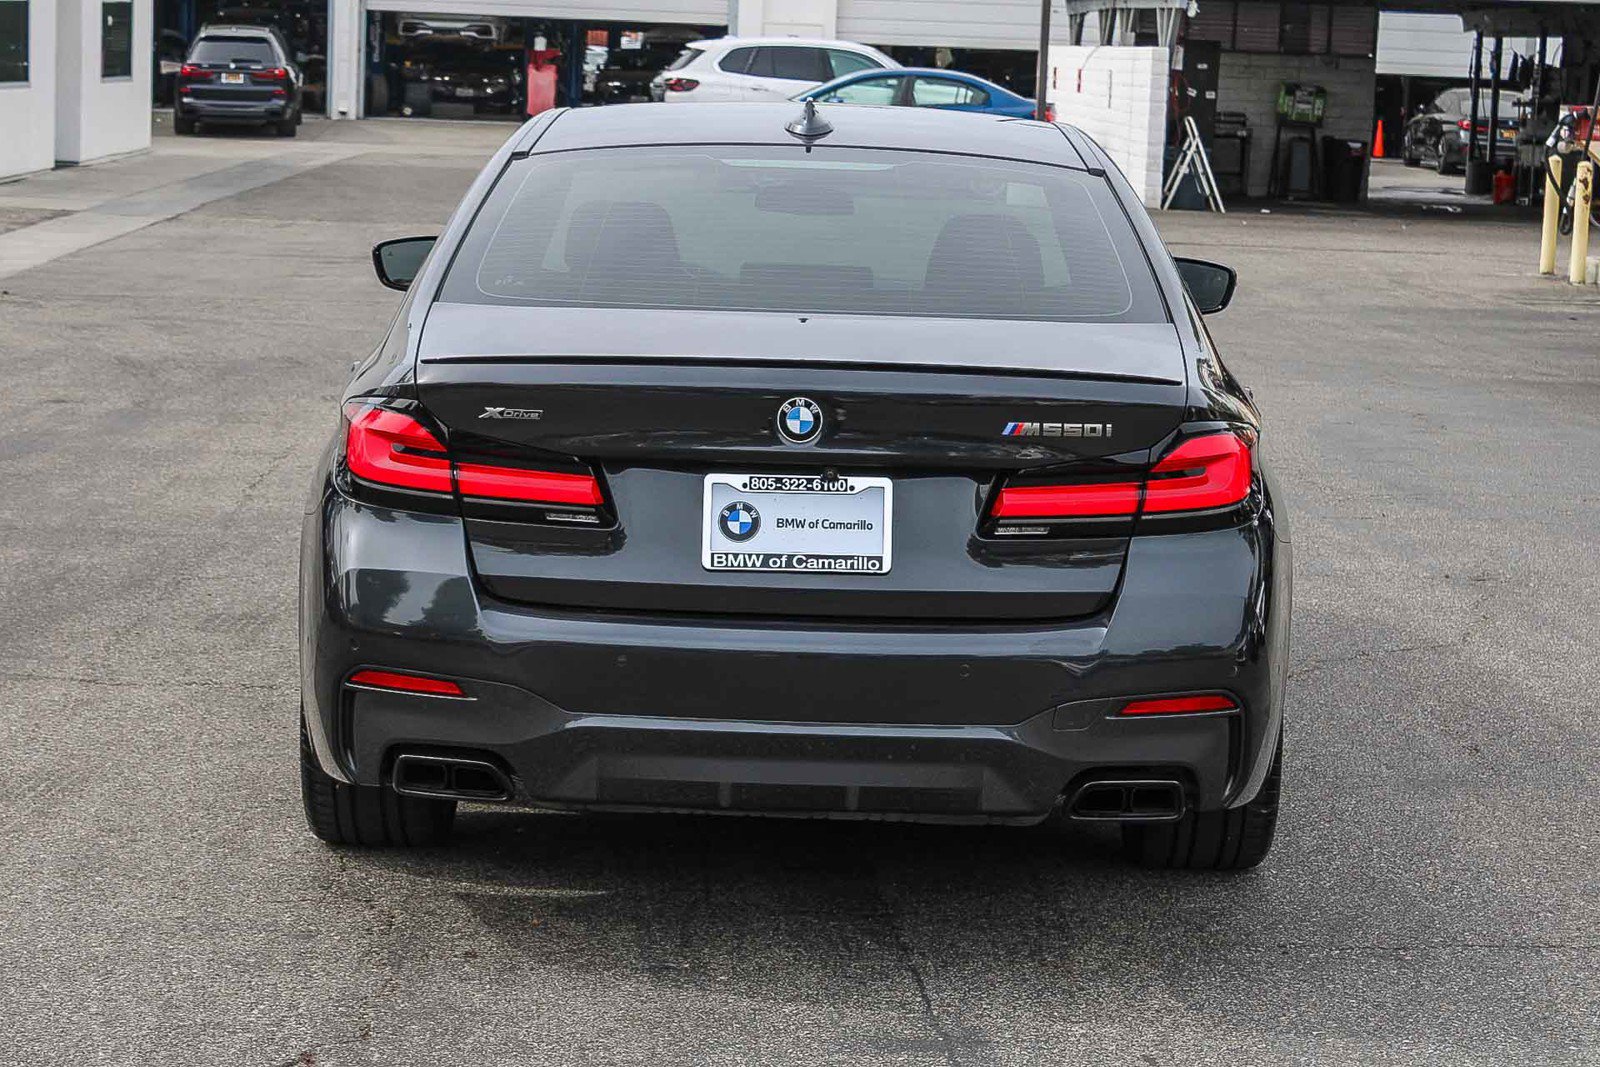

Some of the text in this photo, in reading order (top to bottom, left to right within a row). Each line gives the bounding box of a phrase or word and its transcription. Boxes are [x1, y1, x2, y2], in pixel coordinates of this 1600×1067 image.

[782, 399, 819, 414] BMW
[750, 477, 847, 492] 805-322-6100
[722, 502, 758, 518] BMW
[776, 517, 874, 531] BMW of Camarillo
[713, 553, 880, 570] BMW of Camarillo
